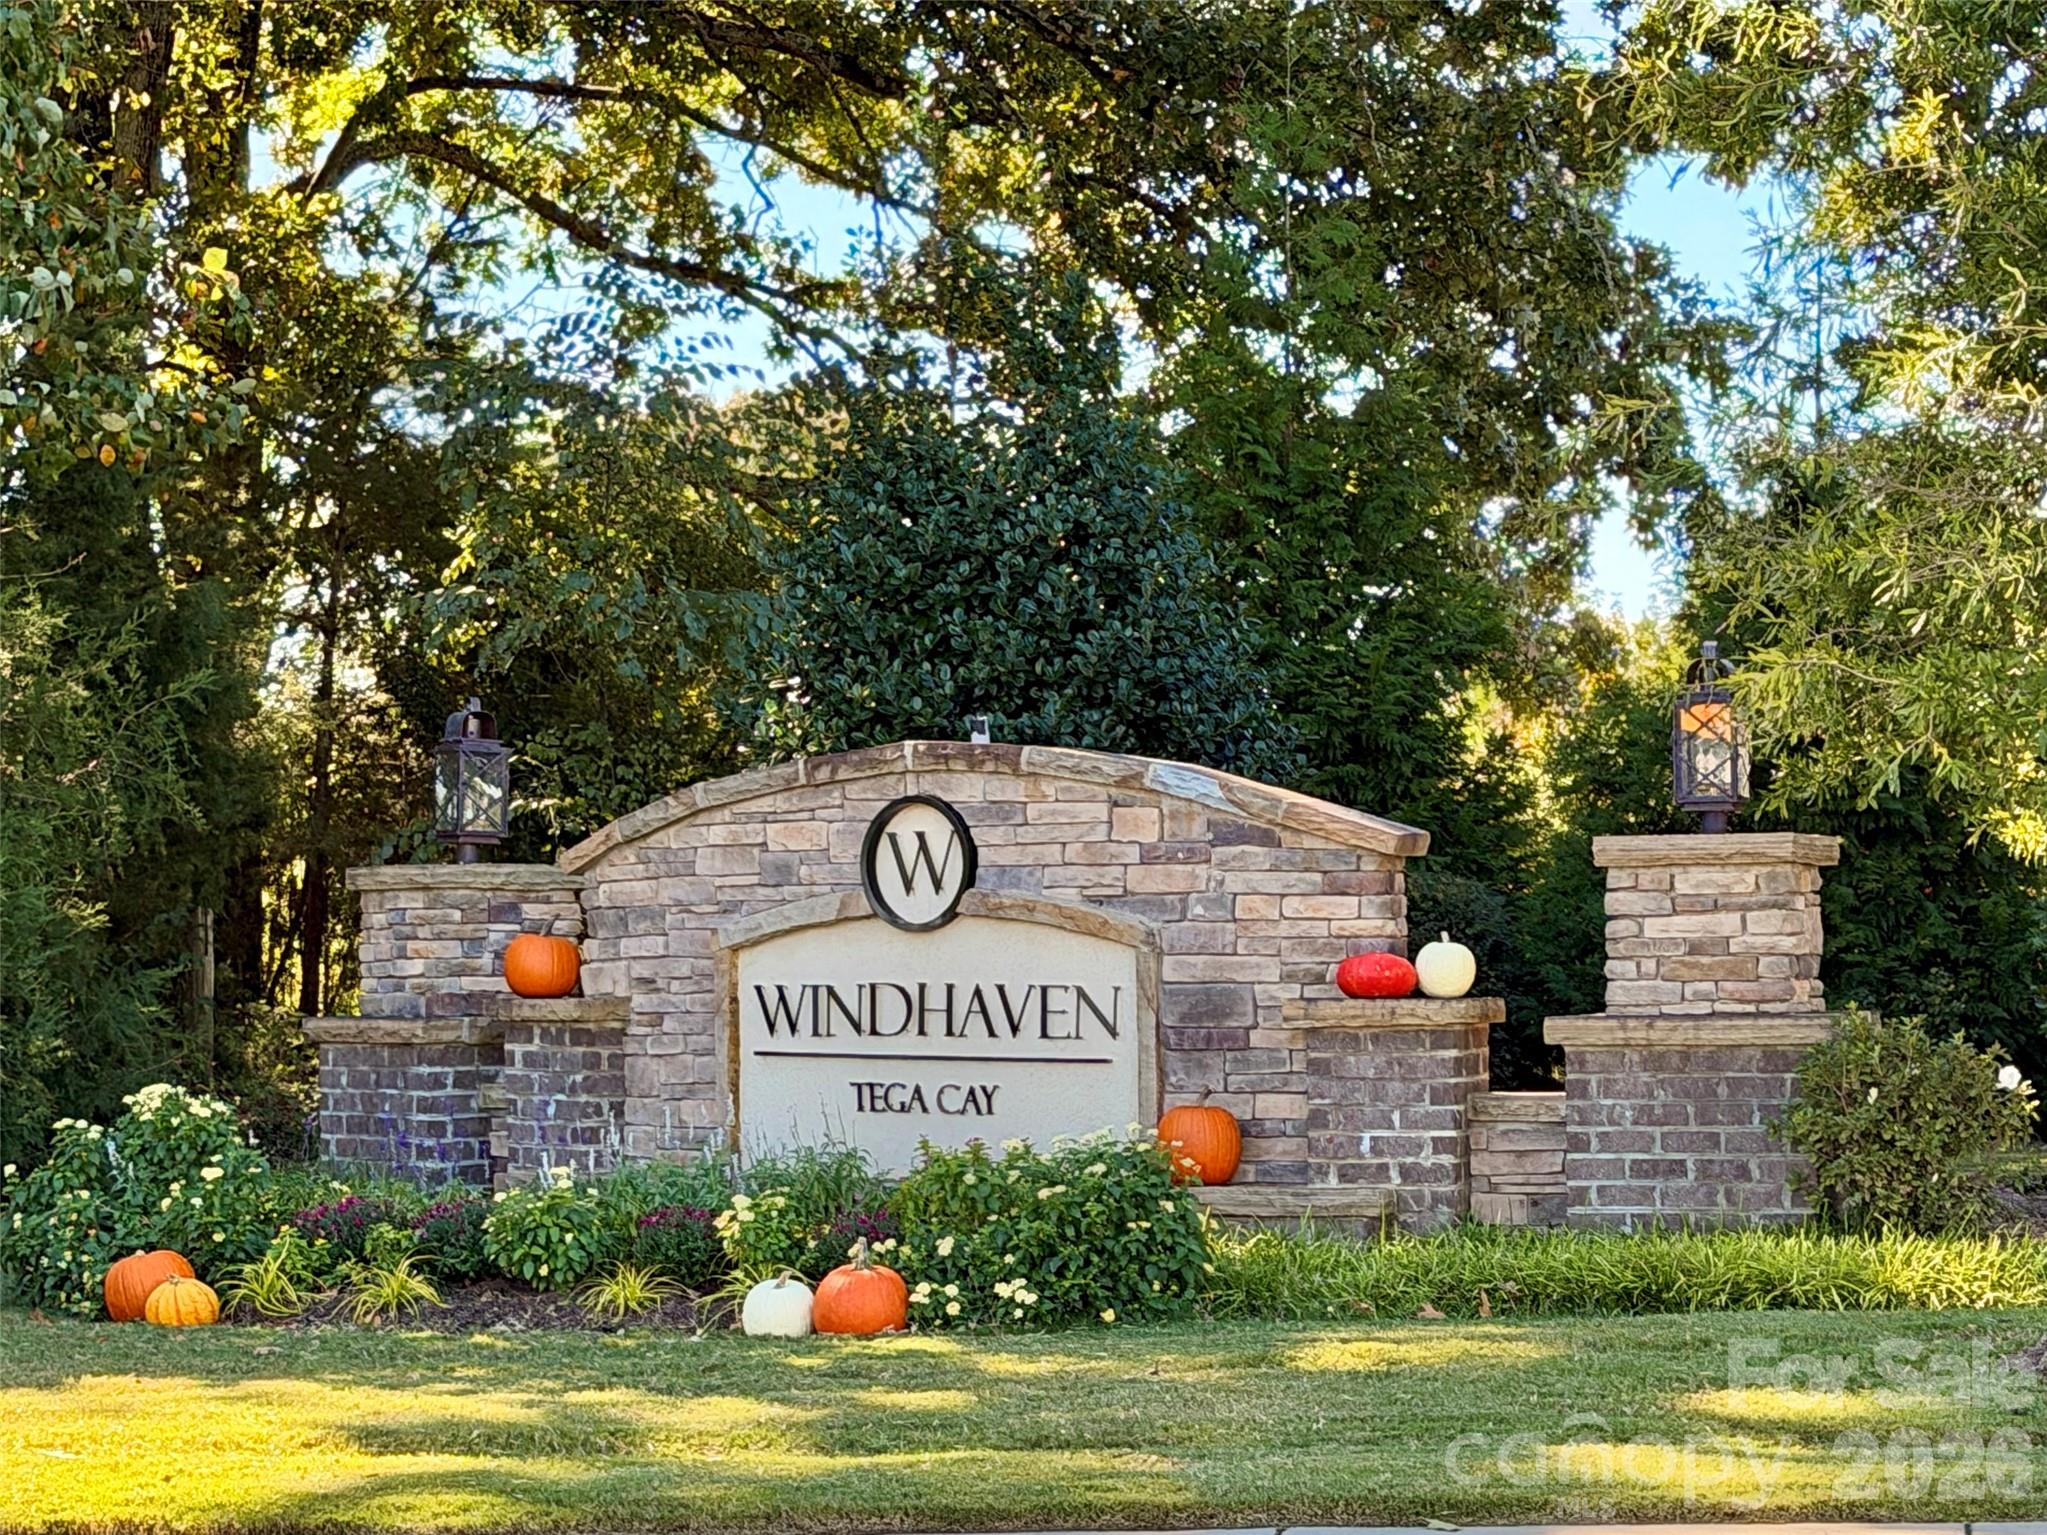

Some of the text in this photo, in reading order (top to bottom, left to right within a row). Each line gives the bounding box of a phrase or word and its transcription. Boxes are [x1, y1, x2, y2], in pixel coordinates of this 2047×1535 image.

[886, 830, 956, 897] W
[753, 981, 1122, 1041] WINDHAVEN
[850, 1081, 1000, 1116] TEGA CAY
